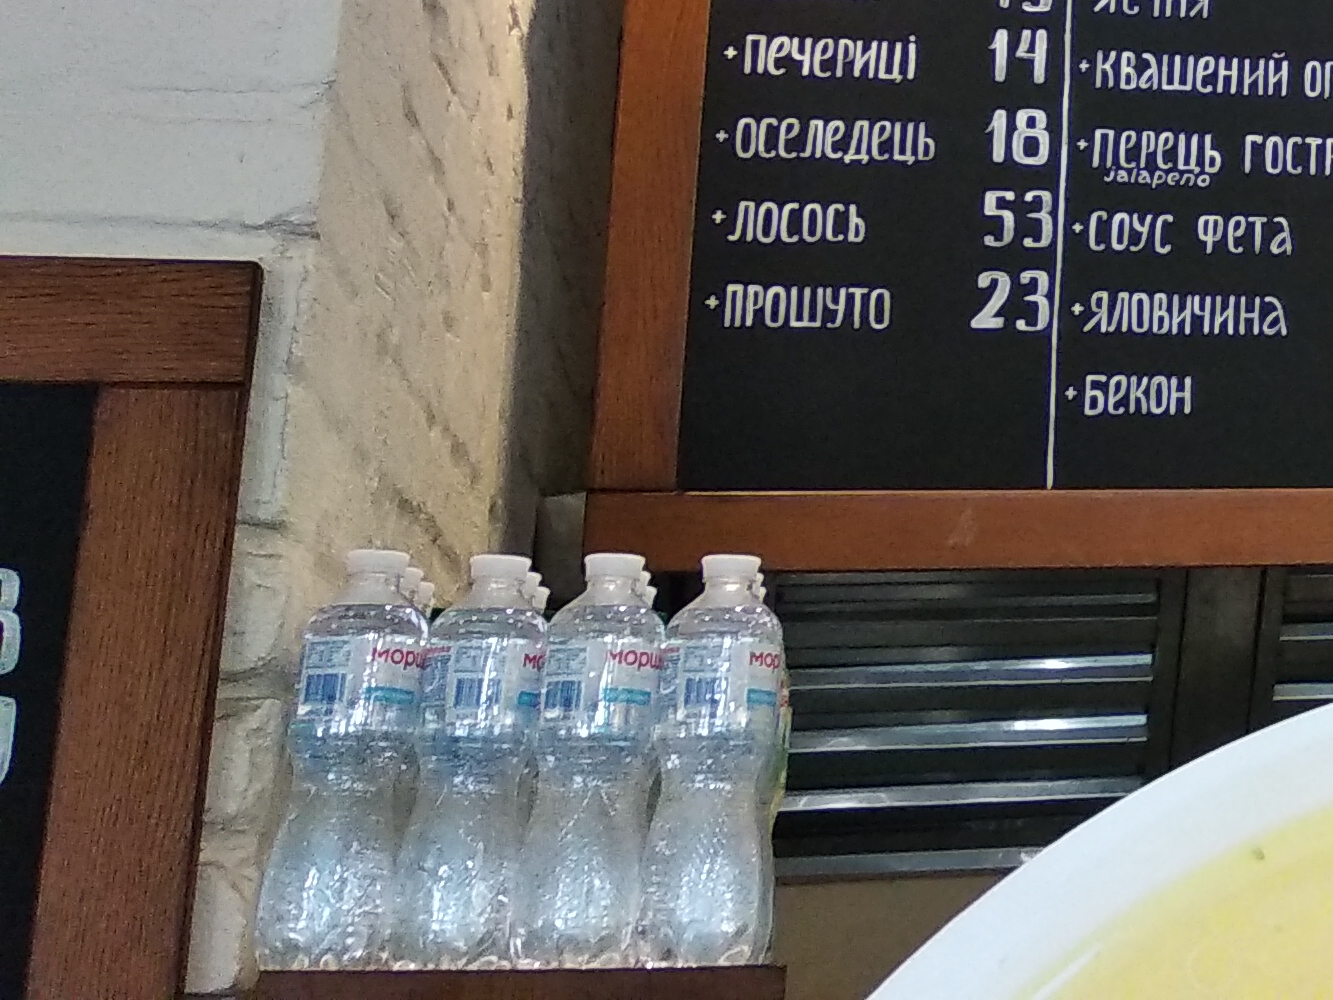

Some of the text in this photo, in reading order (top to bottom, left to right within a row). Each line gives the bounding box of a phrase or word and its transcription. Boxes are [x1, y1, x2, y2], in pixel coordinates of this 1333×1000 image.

[988, 29, 1047, 84] 14
[985, 109, 1049, 165] 18
[1104, 166, 1210, 188] jalapeno
[984, 190, 1053, 247] 53
[1198, 215, 1292, 255] фета
[970, 270, 1054, 336] 23
